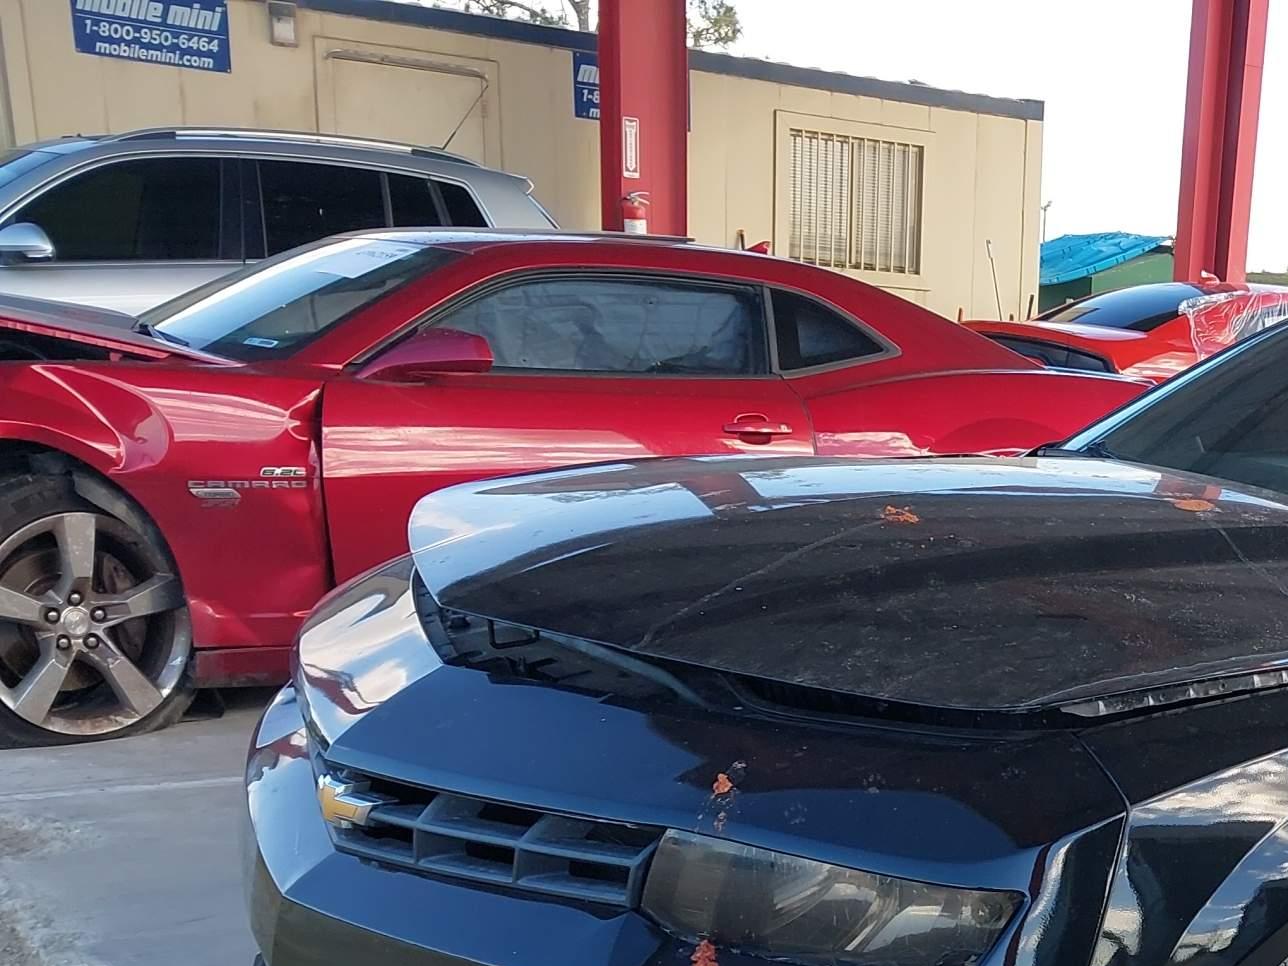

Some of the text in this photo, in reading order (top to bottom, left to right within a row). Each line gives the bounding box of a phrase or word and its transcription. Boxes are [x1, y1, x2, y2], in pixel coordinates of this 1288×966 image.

[166, 4, 223, 31] mini
[84, 19, 219, 53] 1-800-950-6464
[95, 41, 214, 69] mobilemini.com
[187, 480, 307, 489] CAMARO
